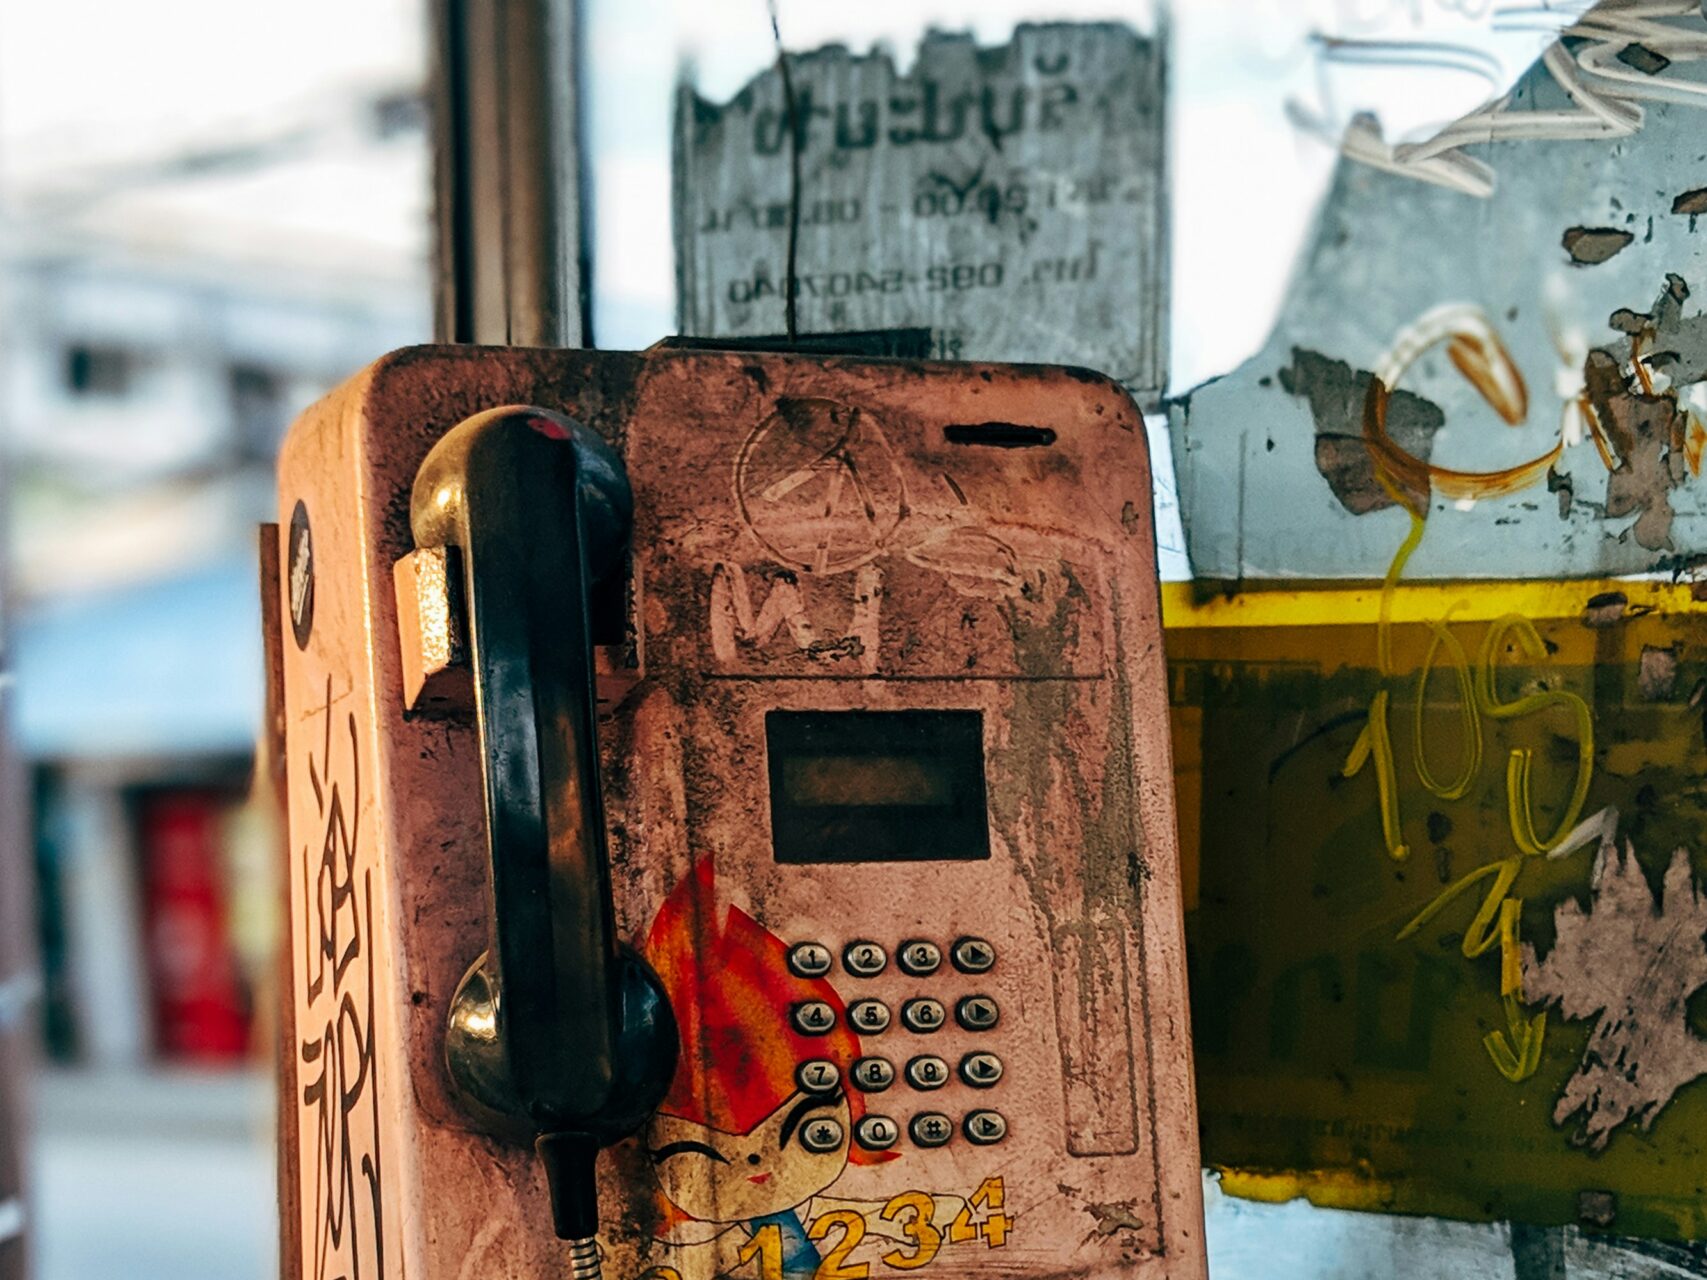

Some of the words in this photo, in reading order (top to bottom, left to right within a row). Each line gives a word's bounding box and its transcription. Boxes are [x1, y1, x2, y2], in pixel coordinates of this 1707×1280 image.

[806, 949, 818, 968] 1
[860, 948, 874, 967] 2
[915, 946, 928, 966] 3
[809, 1006, 824, 1024] 4
[864, 1005, 878, 1024] 5
[919, 1004, 933, 1024] 6
[813, 1065, 827, 1084] 7
[868, 1062, 882, 1083] 8
[922, 1062, 937, 1081] 9
[871, 1121, 887, 1141] 0
